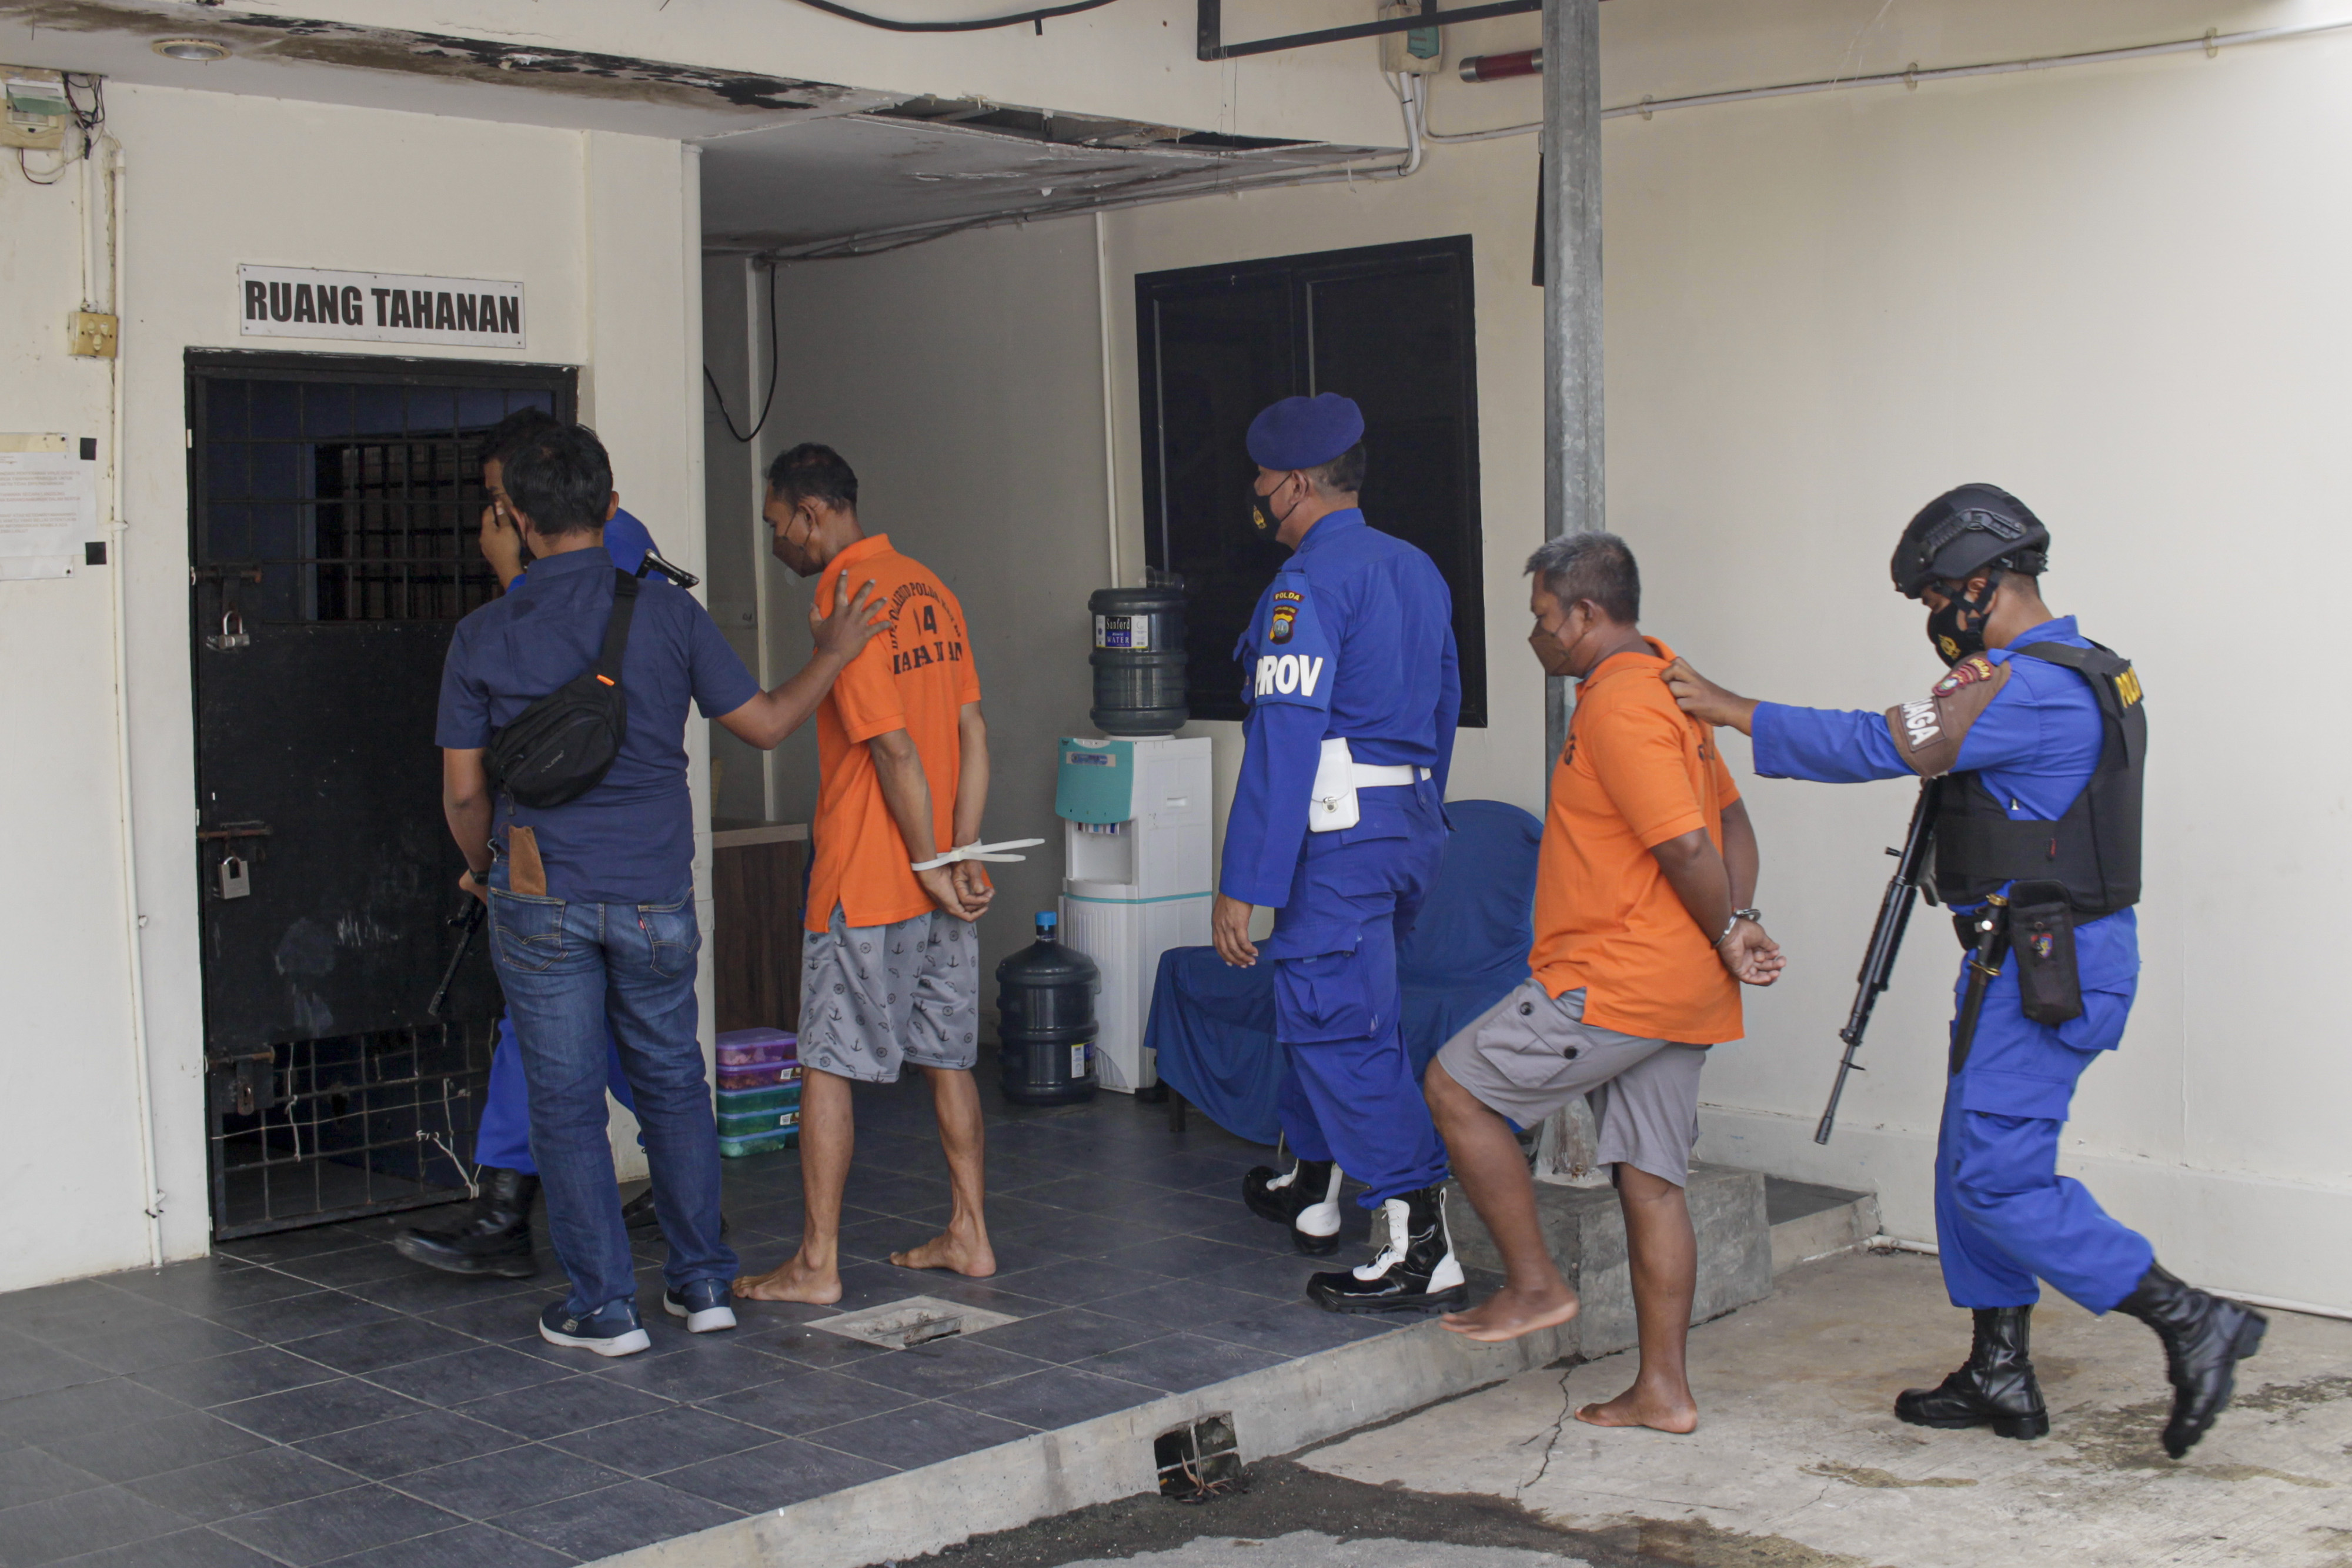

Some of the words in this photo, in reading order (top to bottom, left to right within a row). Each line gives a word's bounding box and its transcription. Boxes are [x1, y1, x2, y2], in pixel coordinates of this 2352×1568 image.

[245, 280, 363, 326] RUANG
[370, 287, 520, 334] TAHANAN
[1275, 591, 1299, 601] POLDA
[1106, 618, 1130, 630] Sanford
